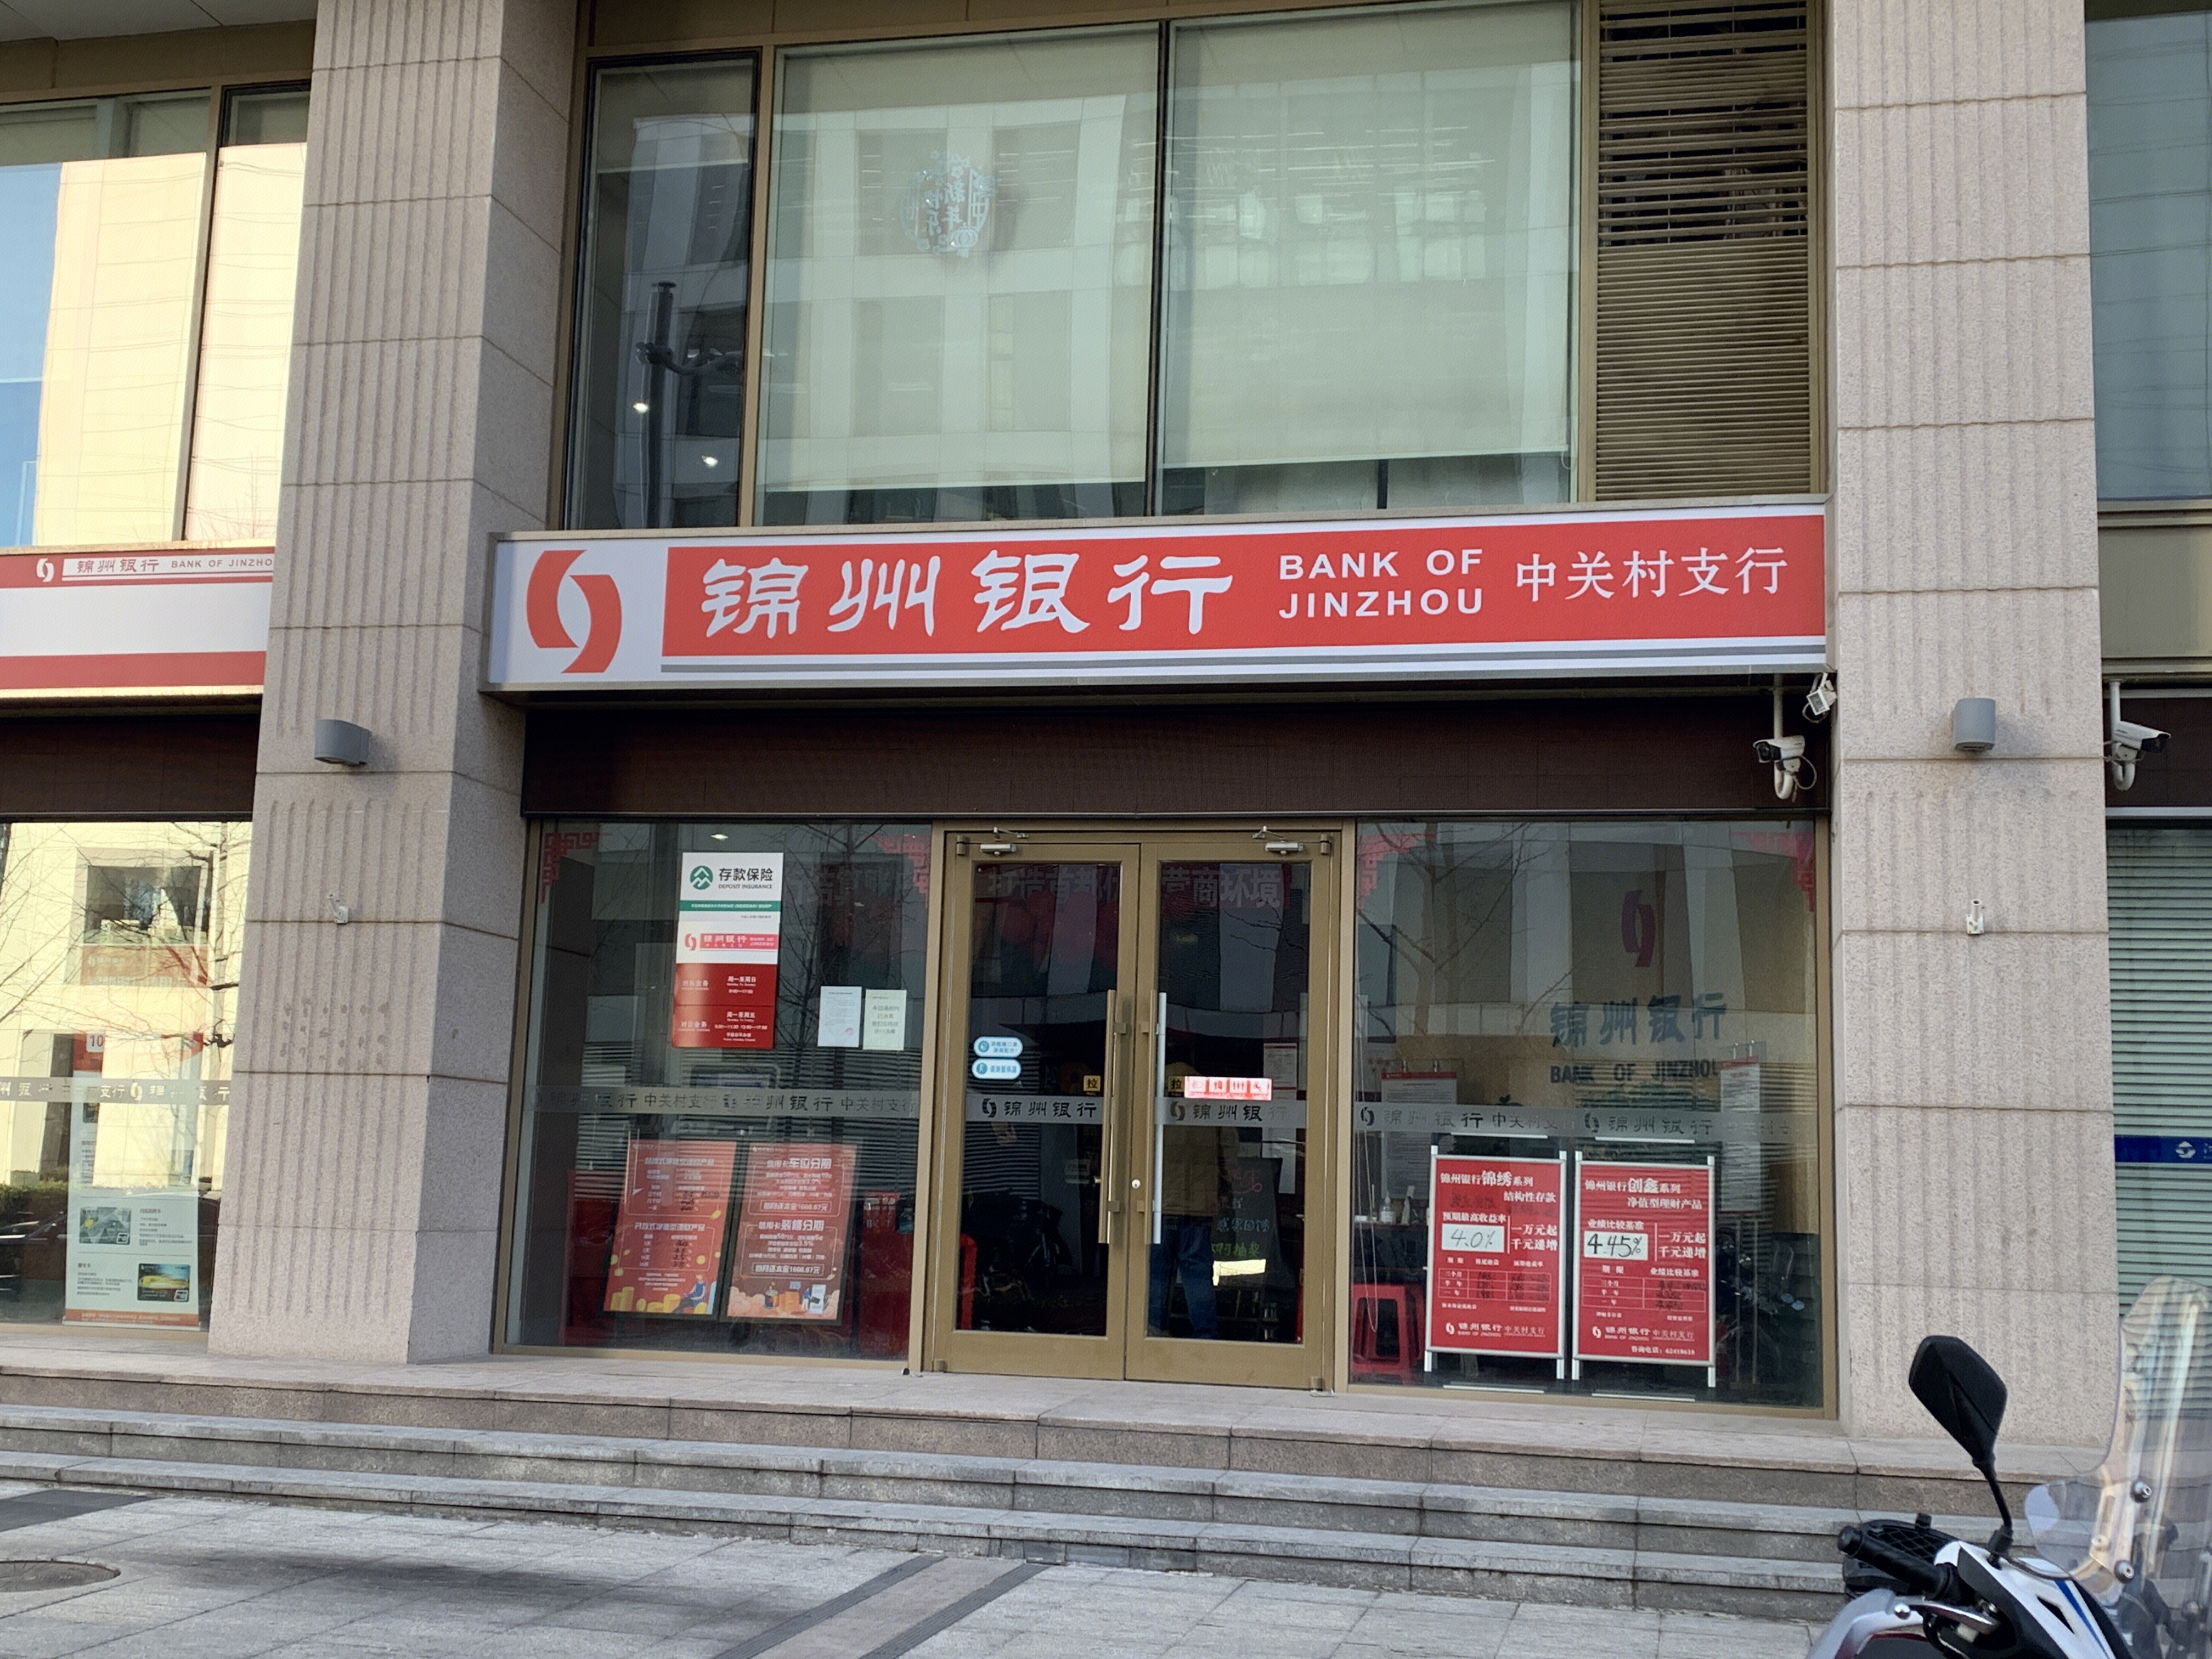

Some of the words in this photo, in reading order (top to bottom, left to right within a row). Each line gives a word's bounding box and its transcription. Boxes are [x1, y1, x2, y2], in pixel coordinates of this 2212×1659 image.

[77, 558, 160, 574] 锦州银行
[171, 560, 201, 568] BANK
[208, 559, 223, 568] OF
[229, 558, 273, 567] JINZHO
[1279, 551, 1398, 580] BANK
[1426, 549, 1483, 576] OF
[1515, 546, 1787, 602] 中关村支行
[702, 550, 1233, 638] 锦州银行
[1279, 588, 1483, 619] JINZHOU
[719, 868, 773, 881] 存款保险
[1086, 1078, 1098, 1088] 拉
[1171, 1079, 1182, 1090] 拉
[1004, 1101, 1097, 1118] 锦州银行
[1504, 1191, 1556, 1203] 结构性存款
[1511, 1224, 1558, 1237] 一万元起
[1658, 1231, 1706, 1244] 一万元起
[1451, 1229, 1496, 1248] 4.0%
[1511, 1238, 1558, 1251] 千元递增
[1587, 1233, 1643, 1258] 4.45%
[1658, 1246, 1706, 1259] 千元递增
